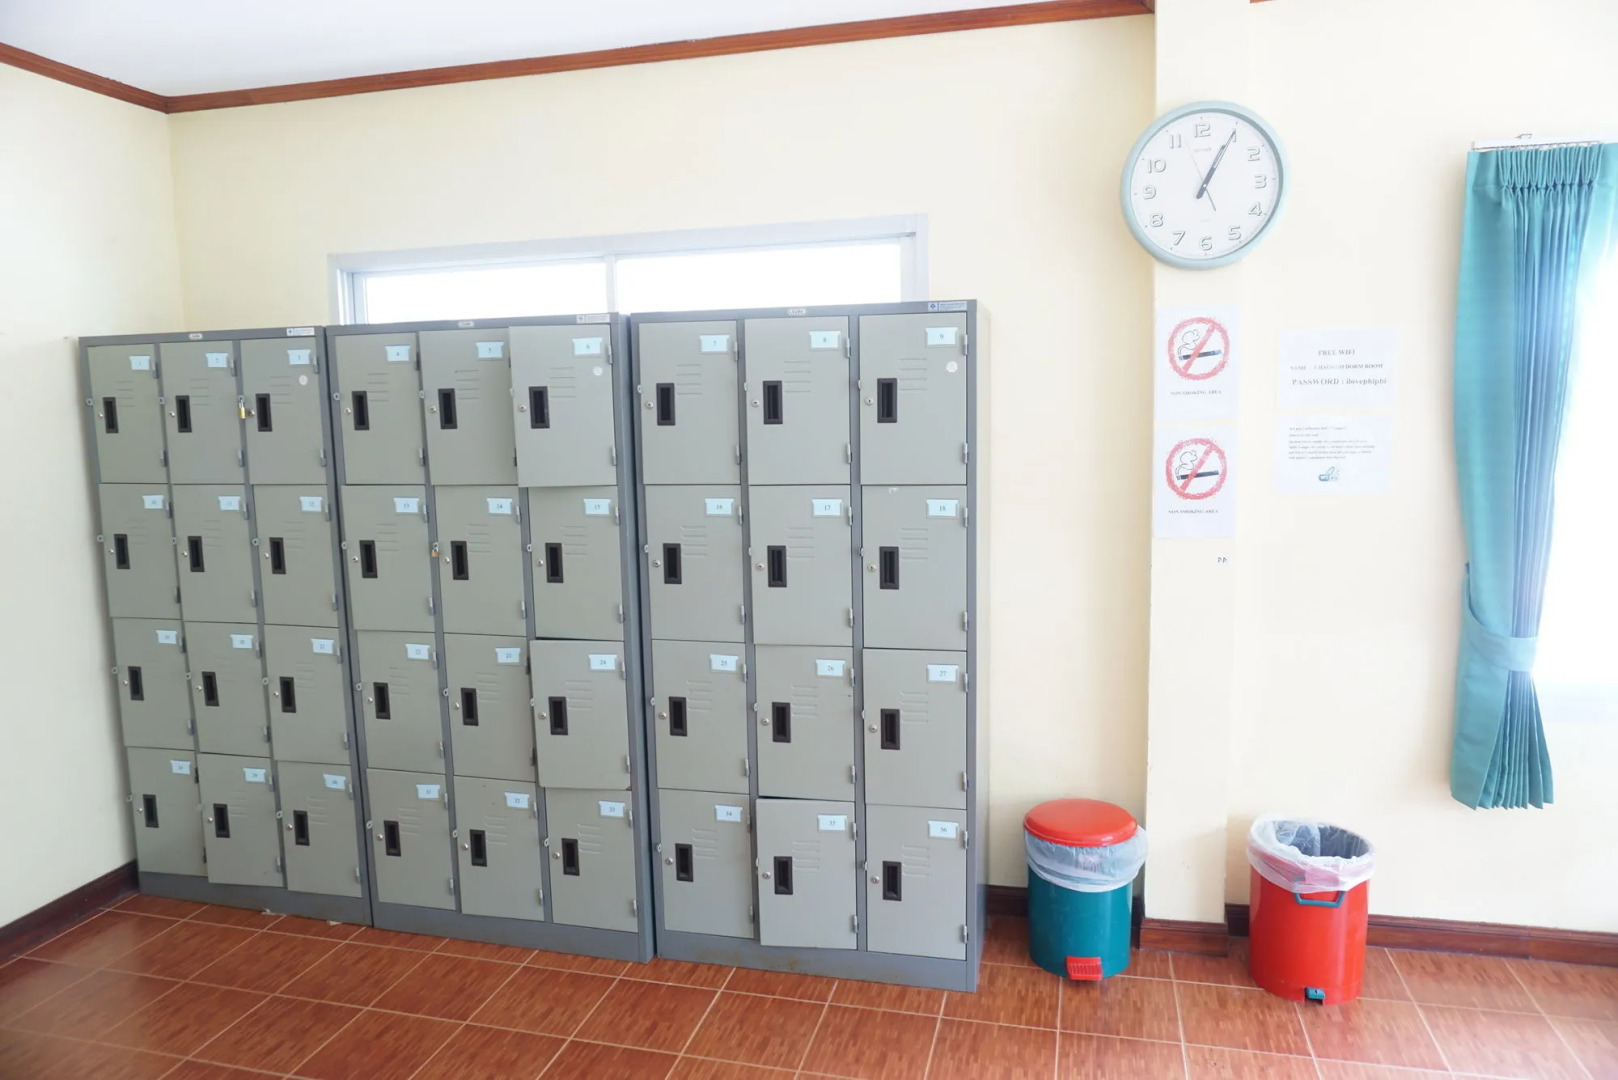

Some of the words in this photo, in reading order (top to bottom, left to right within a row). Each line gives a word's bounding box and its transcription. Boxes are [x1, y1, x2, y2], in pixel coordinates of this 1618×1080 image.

[1194, 123, 1211, 138] 12
[1169, 134, 1181, 148] 11
[1248, 148, 1260, 161] 2
[1148, 159, 1166, 174] 10
[1254, 175, 1267, 189] 3
[1143, 185, 1156, 200] 9
[1248, 202, 1262, 216] 4
[1152, 214, 1164, 227] 8
[1173, 231, 1185, 246] 7
[1228, 226, 1241, 241] 5
[1200, 237, 1213, 251] 6
